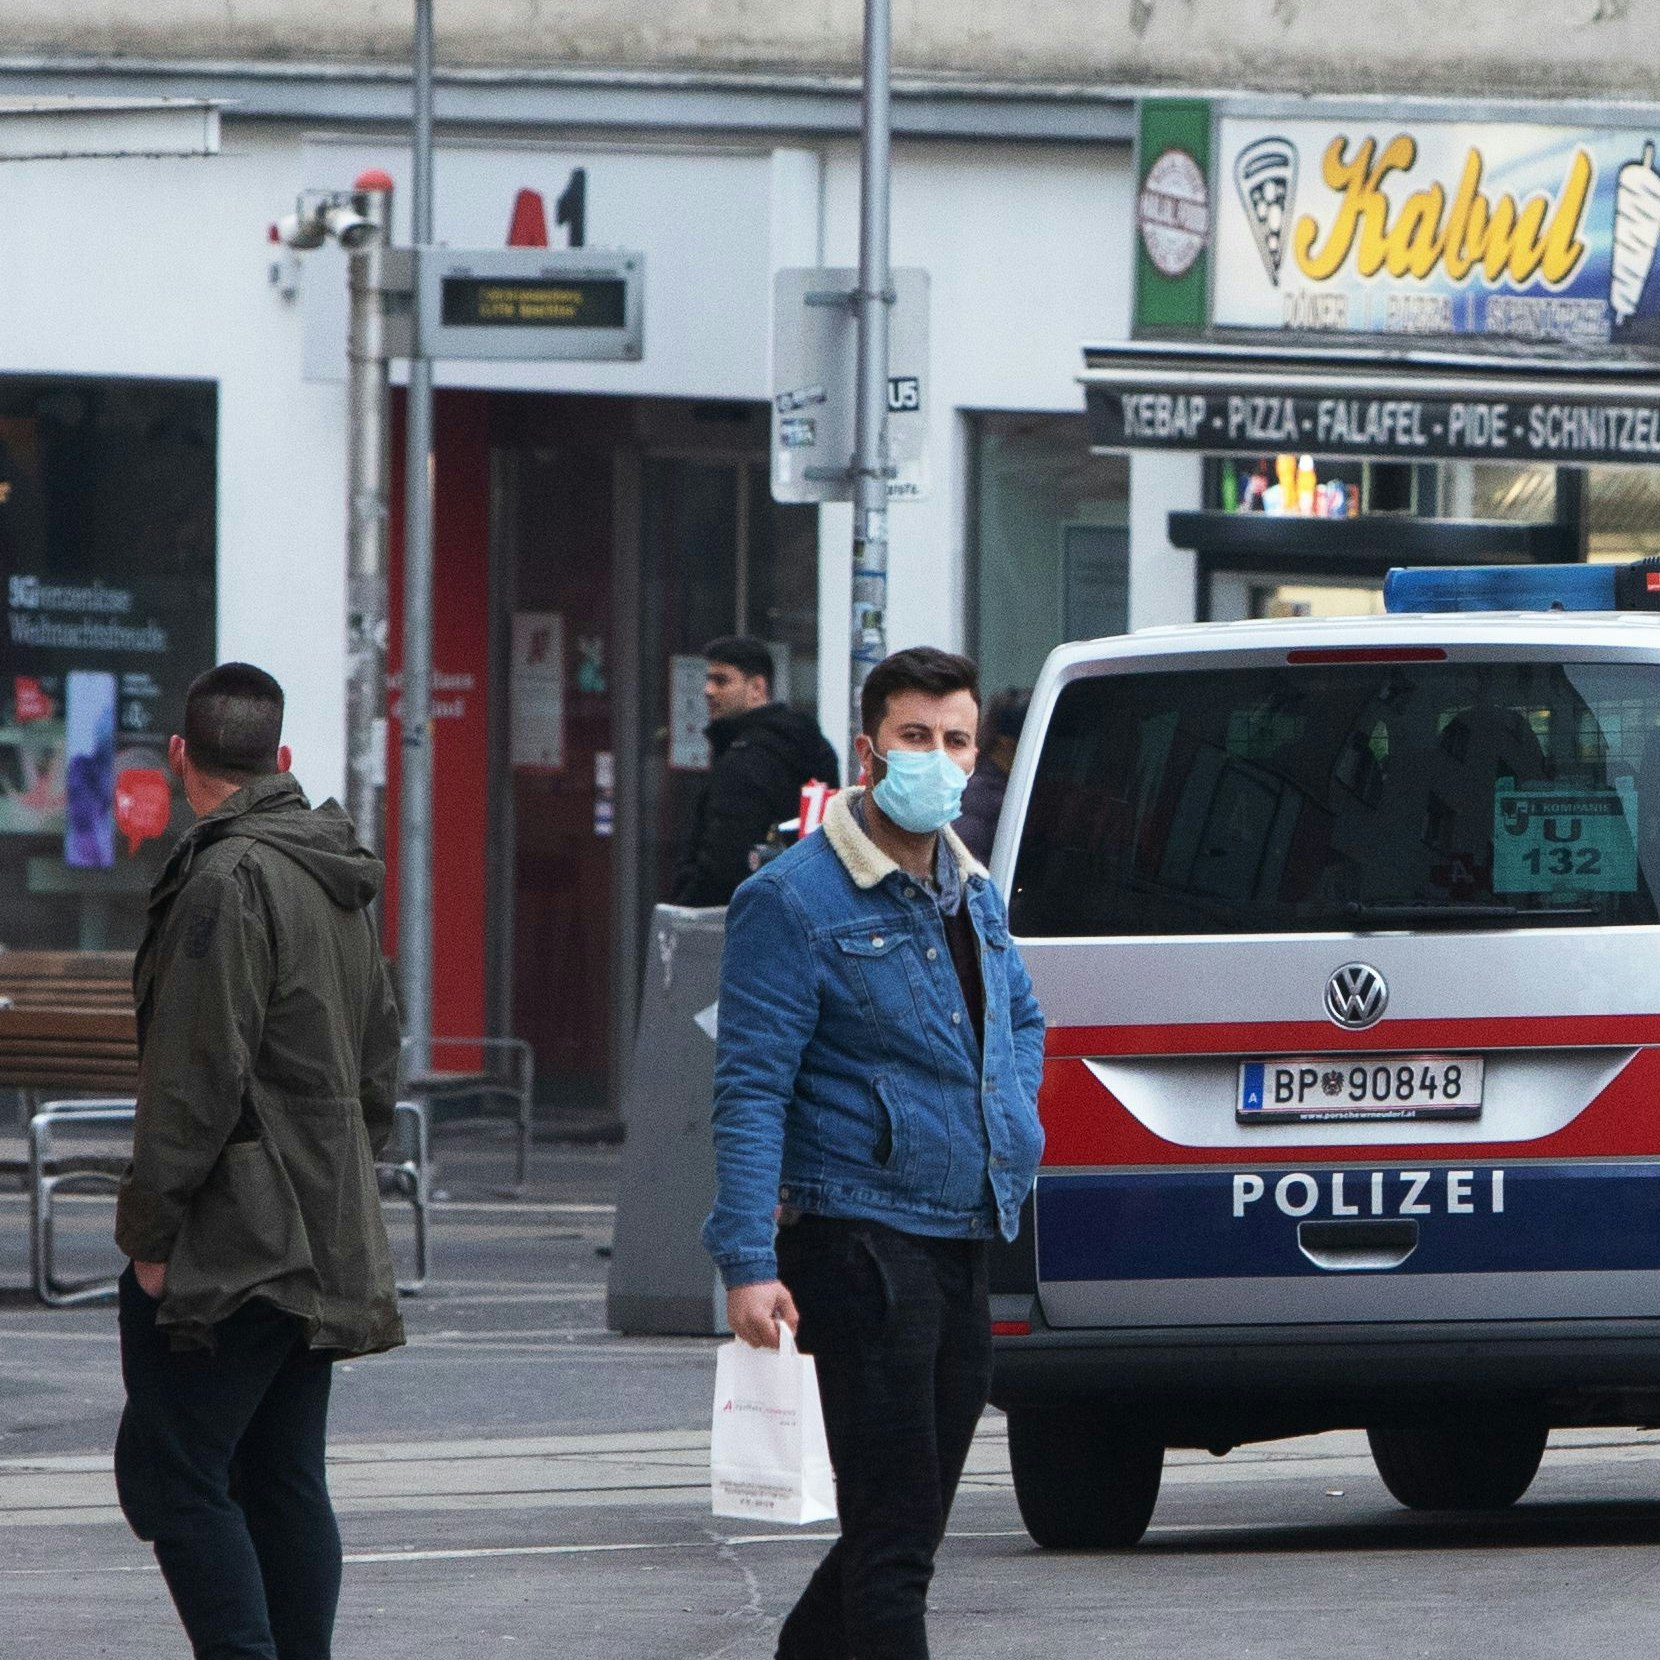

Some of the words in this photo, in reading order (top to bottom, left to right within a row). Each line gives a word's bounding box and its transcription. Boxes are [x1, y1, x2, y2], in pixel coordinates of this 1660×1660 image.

[507, 167, 586, 247] A1
[1293, 133, 1593, 284] Kabul
[889, 380, 919, 409] U5
[1121, 394, 1206, 438] KEBAP
[1228, 396, 1299, 441] PIZZA
[1318, 399, 1428, 446] FALAFEL
[1449, 403, 1508, 448] PIDE
[1543, 818, 1582, 843] U
[1522, 848, 1601, 875] 132
[1248, 1092, 1259, 1104] A
[1274, 1068, 1318, 1104] BP
[1348, 1064, 1462, 1102] 90848
[1233, 1170, 1504, 1217] POLIZEI
